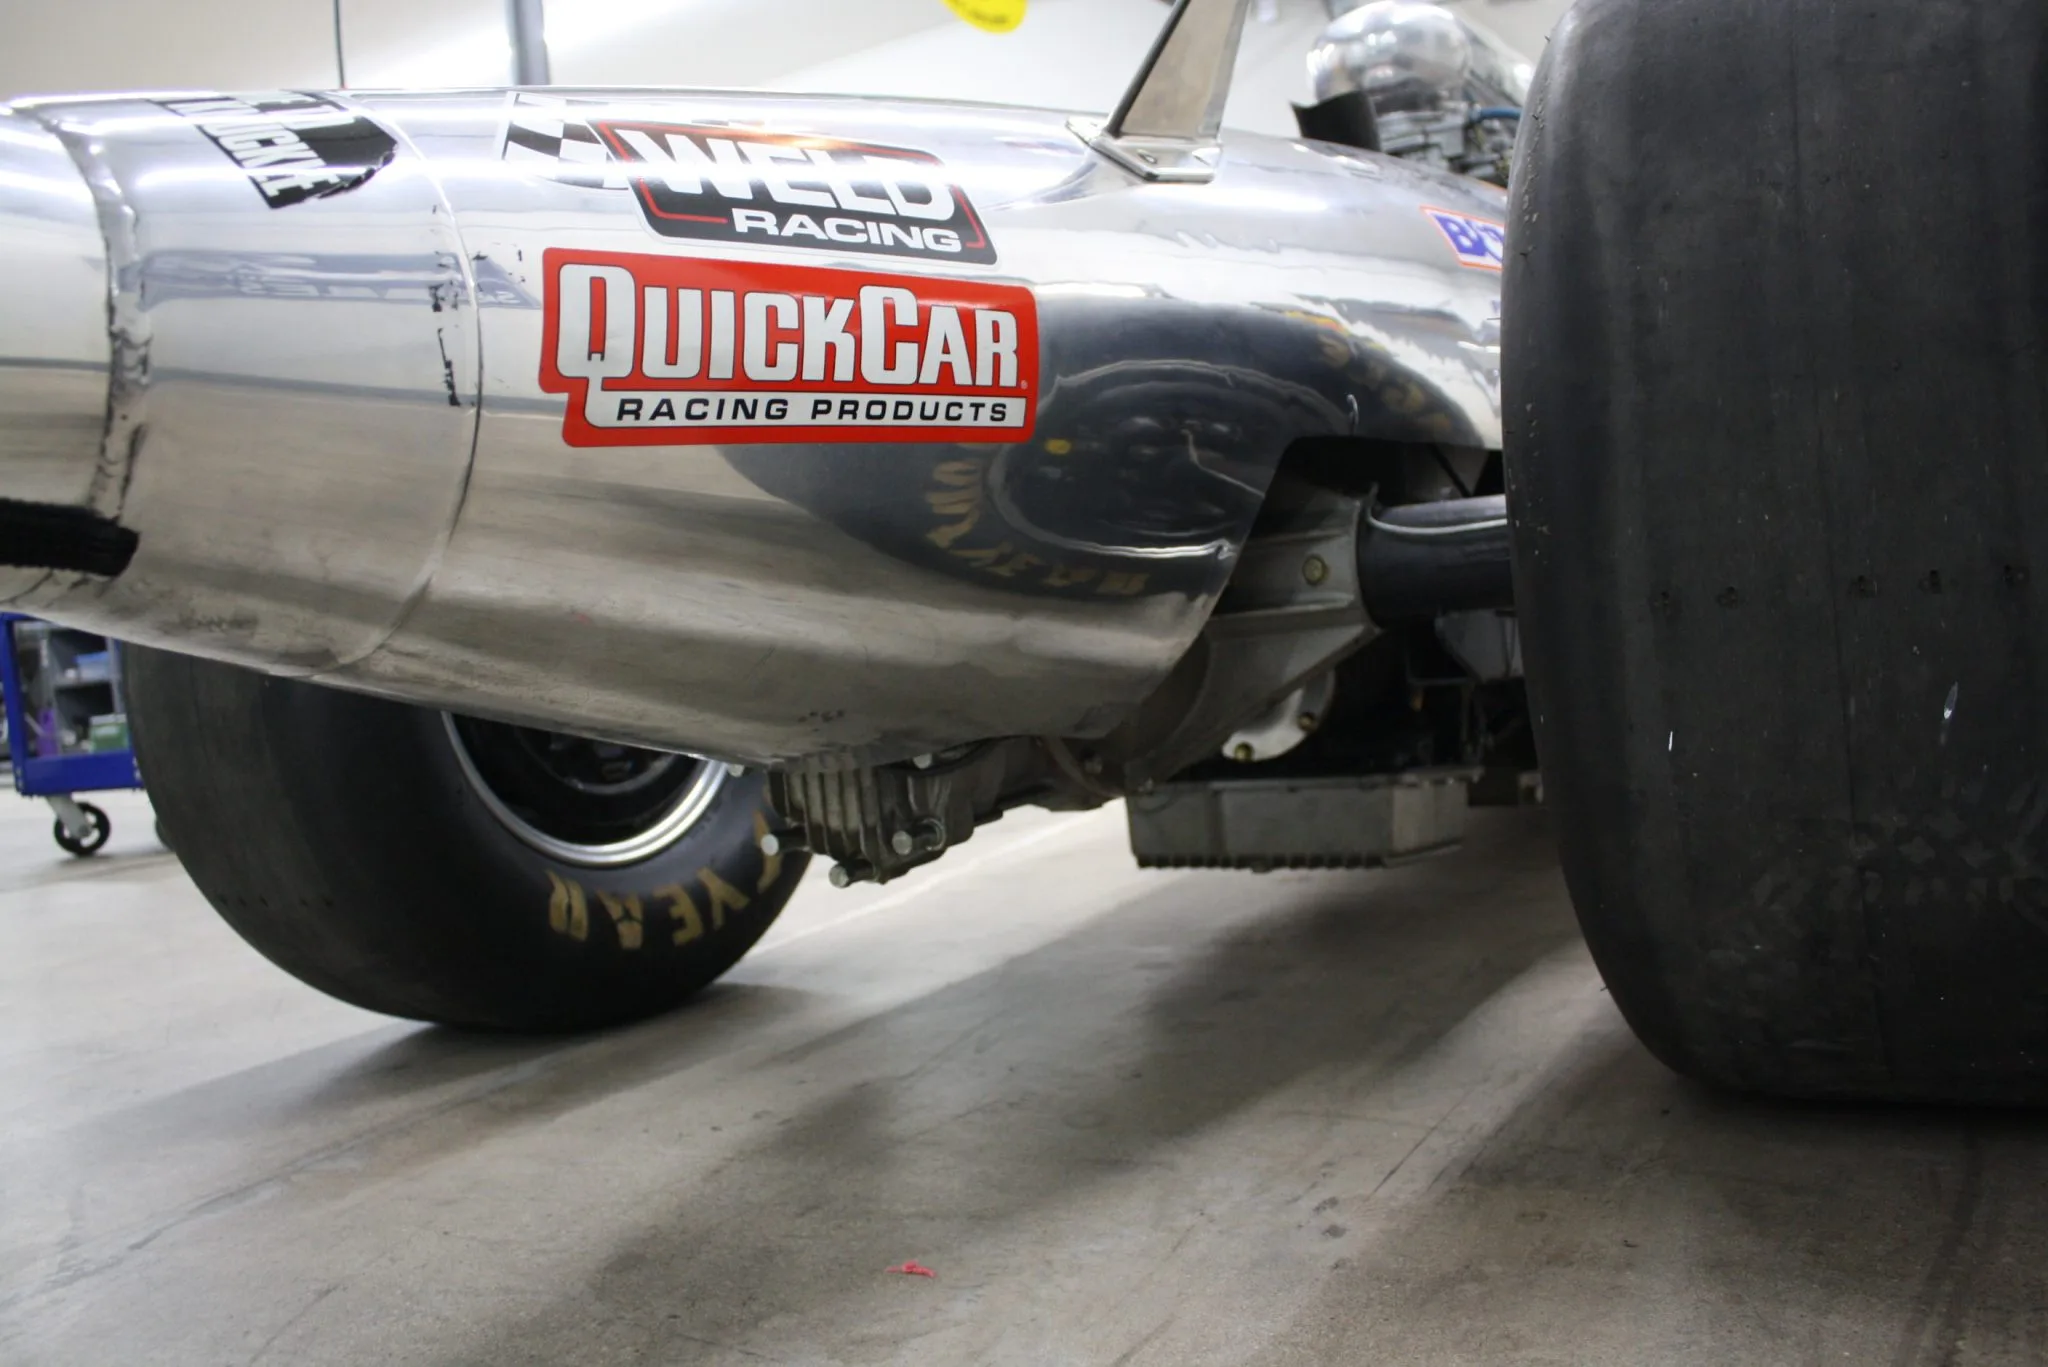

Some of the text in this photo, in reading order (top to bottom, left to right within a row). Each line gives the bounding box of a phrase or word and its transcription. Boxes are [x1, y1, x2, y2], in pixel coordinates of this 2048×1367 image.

[615, 129, 956, 221] WELD
[731, 207, 962, 254] RACING
[556, 263, 1018, 388] QUICKCAR
[616, 398, 1007, 422] RACING PRODUCTS
